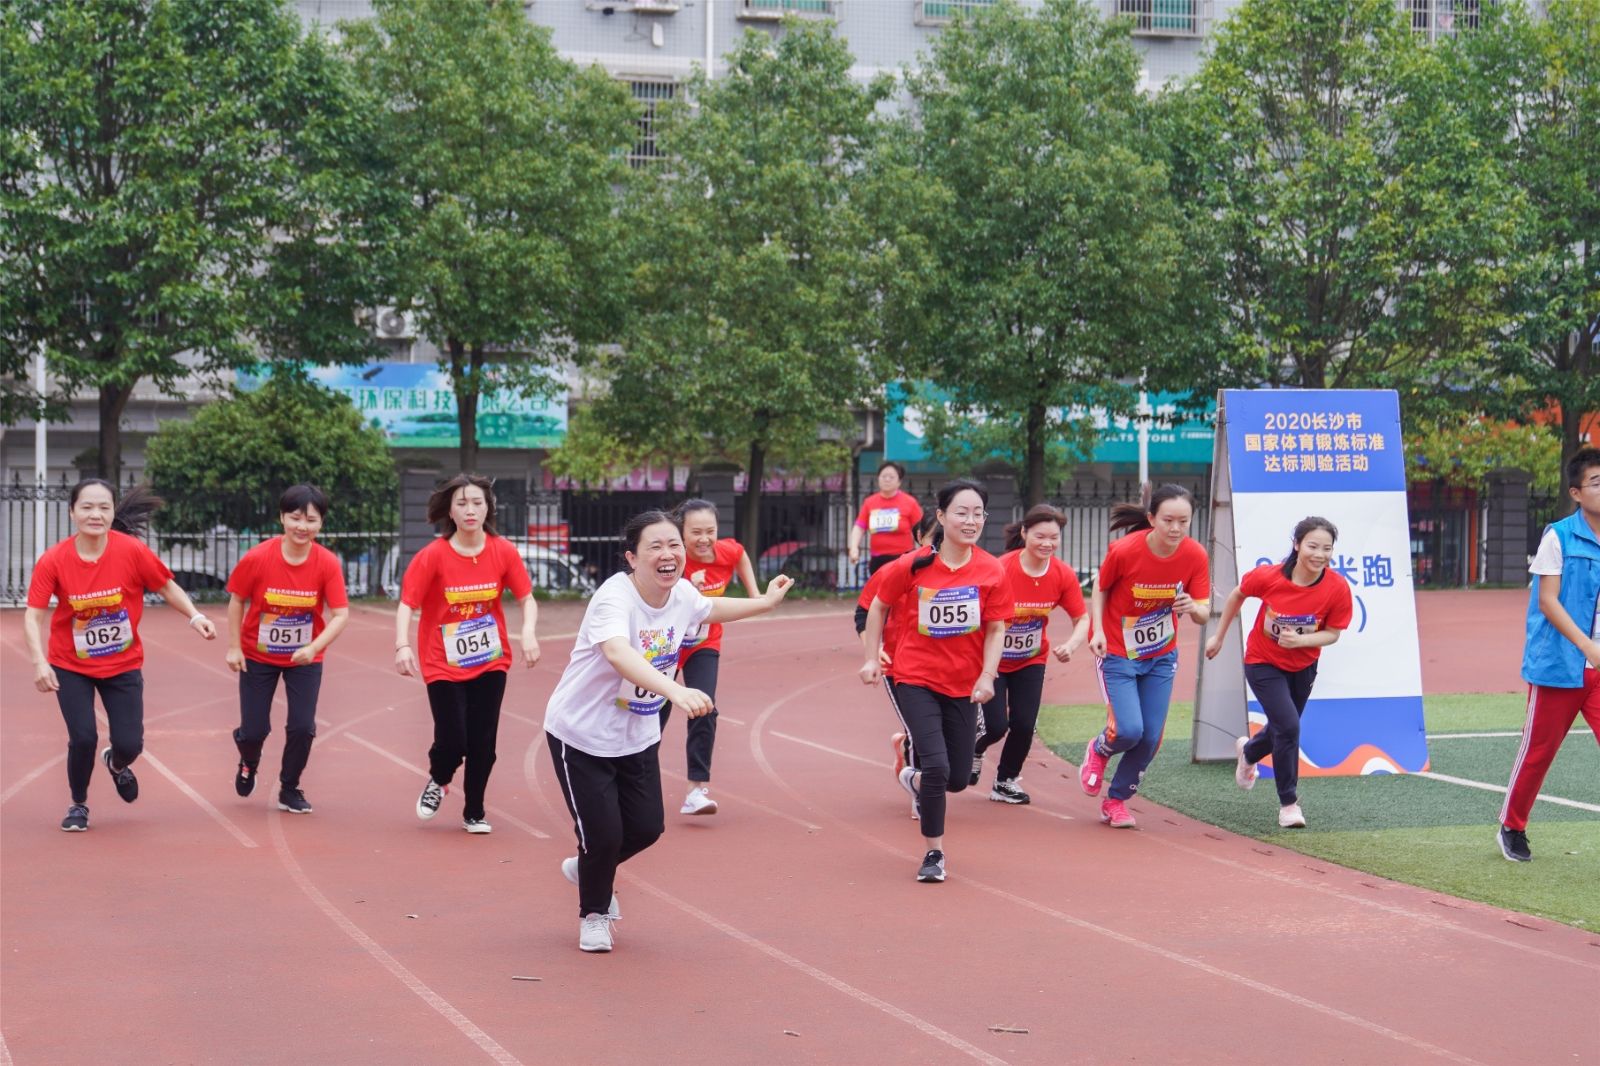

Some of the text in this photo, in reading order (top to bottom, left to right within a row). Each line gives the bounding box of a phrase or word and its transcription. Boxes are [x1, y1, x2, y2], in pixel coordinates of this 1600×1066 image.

[340, 388, 549, 411] 环保科技限公司
[1264, 412, 1362, 431] 2020长沙市
[1244, 433, 1385, 452] 国家体育锻炼标准
[1264, 454, 1369, 473] 达标测验活动
[929, 605, 968, 624] 055
[85, 626, 122, 646] 062
[269, 628, 302, 643] 051
[1134, 621, 1165, 644] 067
[1271, 622, 1304, 637] 04
[456, 631, 490, 655] 054
[1003, 633, 1034, 650] 056
